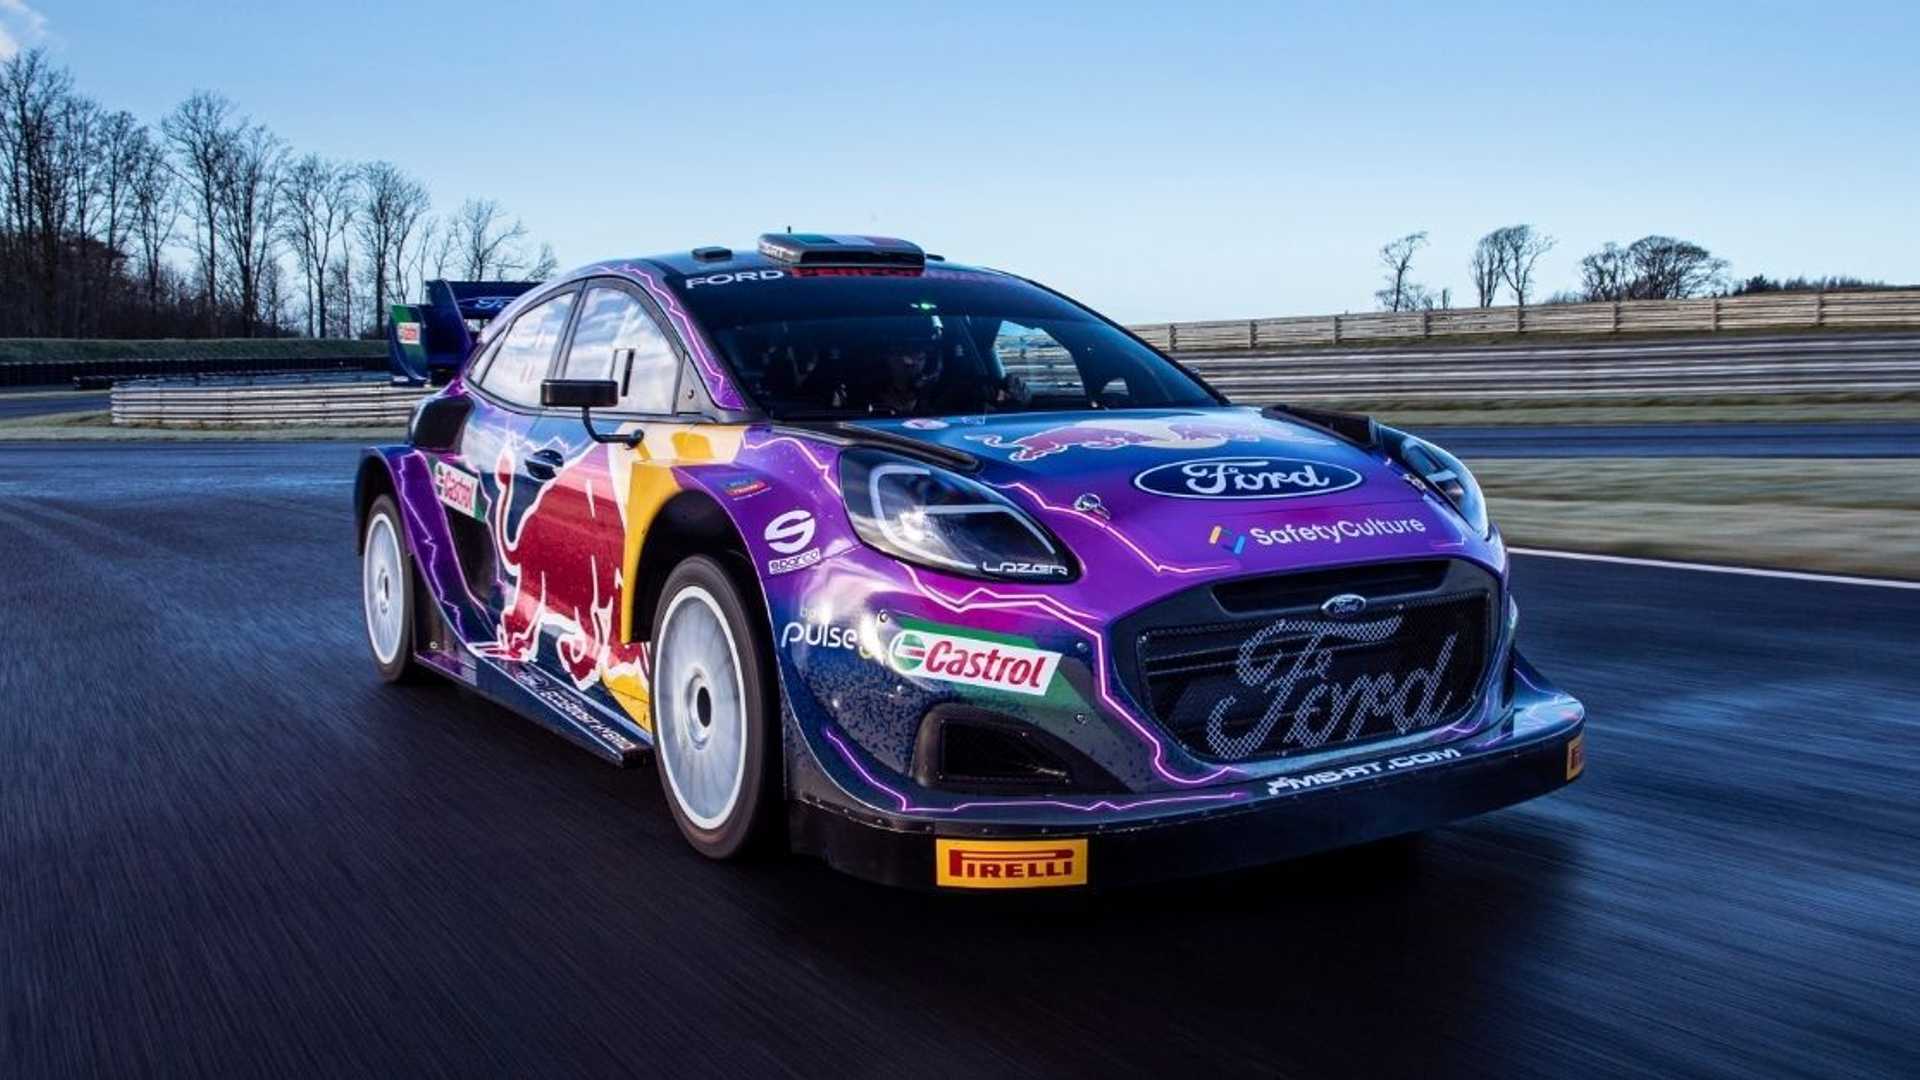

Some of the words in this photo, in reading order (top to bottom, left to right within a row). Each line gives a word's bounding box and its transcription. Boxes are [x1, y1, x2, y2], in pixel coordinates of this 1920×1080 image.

[686, 269, 784, 289] FORD
[1181, 460, 1330, 494] Ford
[1250, 517, 1426, 545] SafetyCulture
[781, 621, 858, 650] pulse
[925, 640, 1047, 688] Castrol
[1206, 614, 1458, 761] Ford
[949, 848, 1075, 878] PIRELLI
